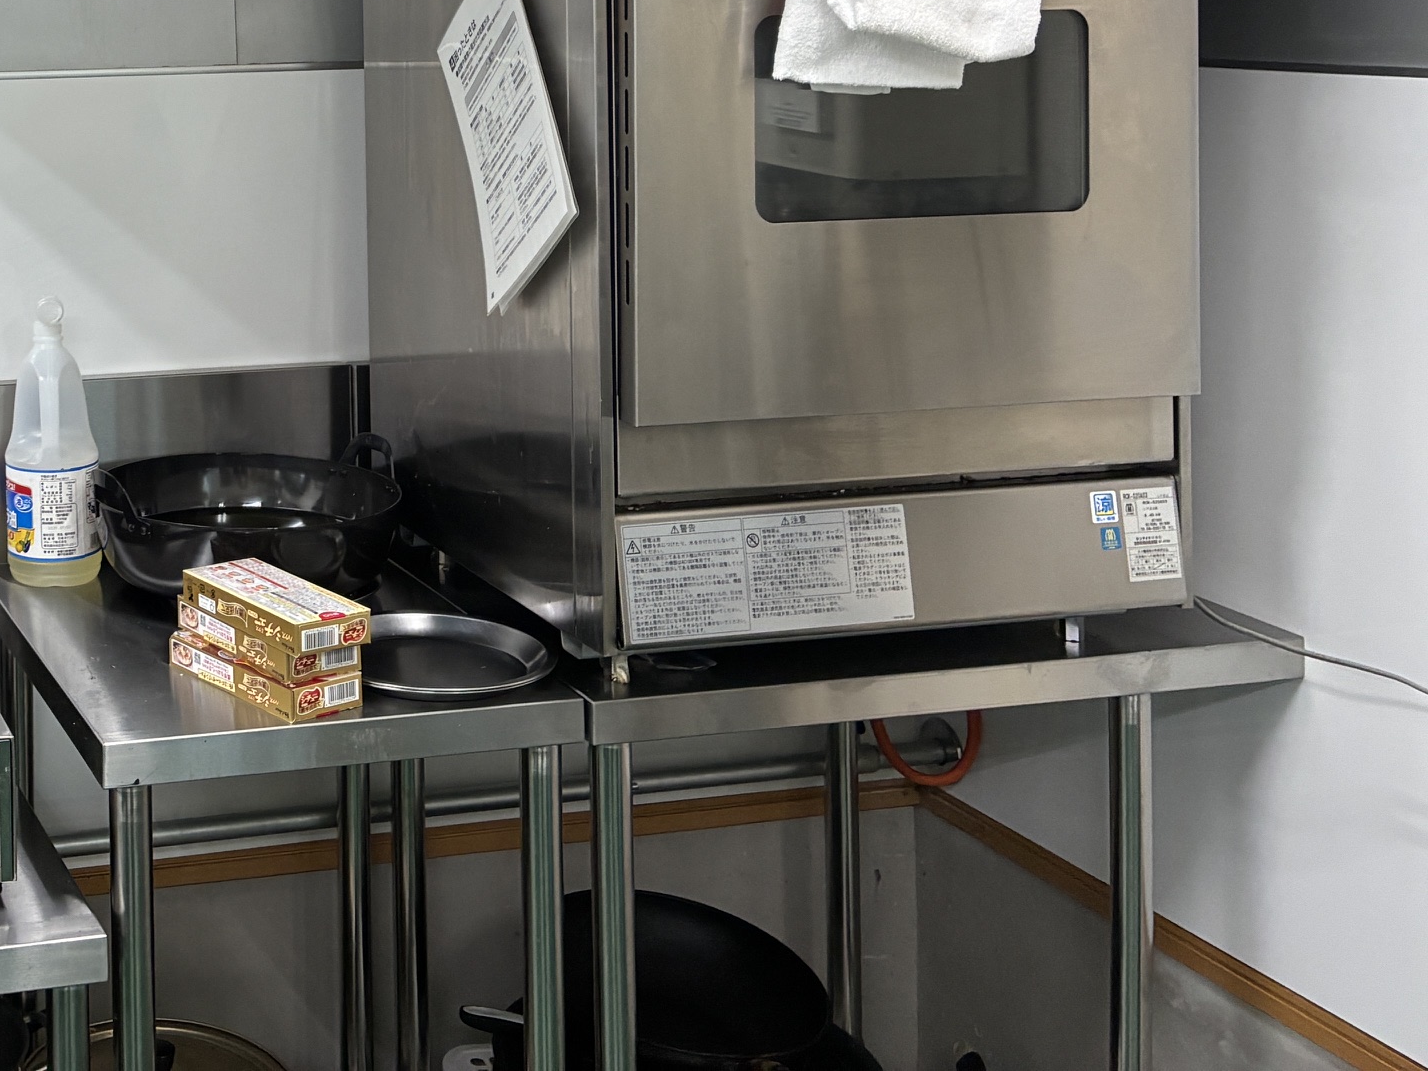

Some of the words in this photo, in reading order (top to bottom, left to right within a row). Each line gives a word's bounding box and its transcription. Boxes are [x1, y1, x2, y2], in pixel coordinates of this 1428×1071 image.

[1096, 496, 1114, 513] 涼
[790, 515, 806, 524] 注意
[680, 523, 695, 532] 警告
